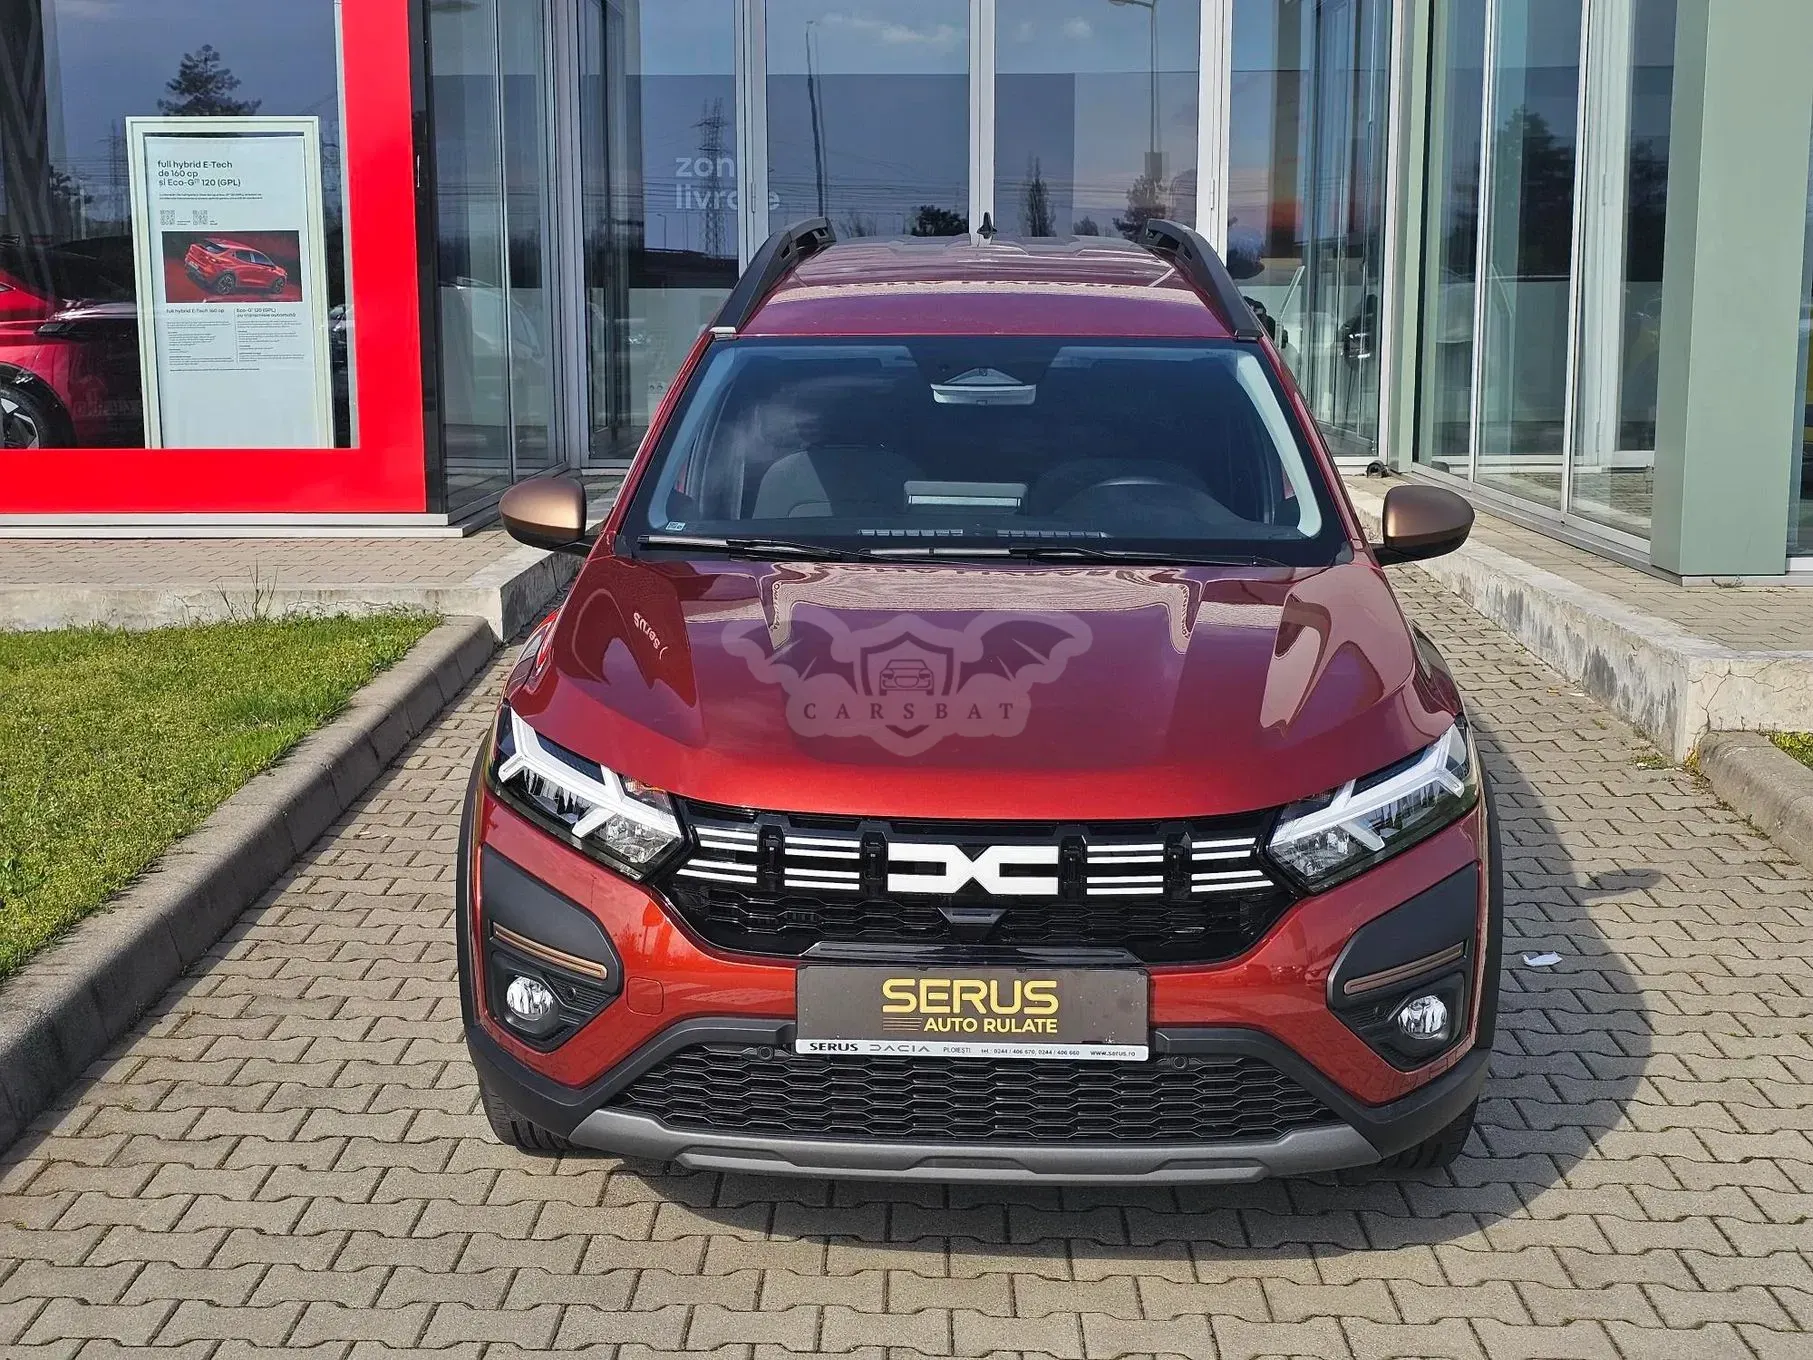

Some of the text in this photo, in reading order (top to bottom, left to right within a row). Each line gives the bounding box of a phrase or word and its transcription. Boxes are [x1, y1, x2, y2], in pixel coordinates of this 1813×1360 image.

[157, 160, 233, 169] full hybrid E-Tech
[675, 157, 735, 178] zon
[158, 169, 170, 177] de
[171, 169, 186, 177] 160
[202, 179, 216, 187] 120
[217, 179, 241, 188] (GPL)
[882, 978, 1059, 1015] SERUS
[923, 1017, 1058, 1033] AUTO RULATE
[809, 1042, 859, 1052] SERUS
[870, 1044, 930, 1053] DACIA
[1090, 1050, 1136, 1058] www.serus.ro
